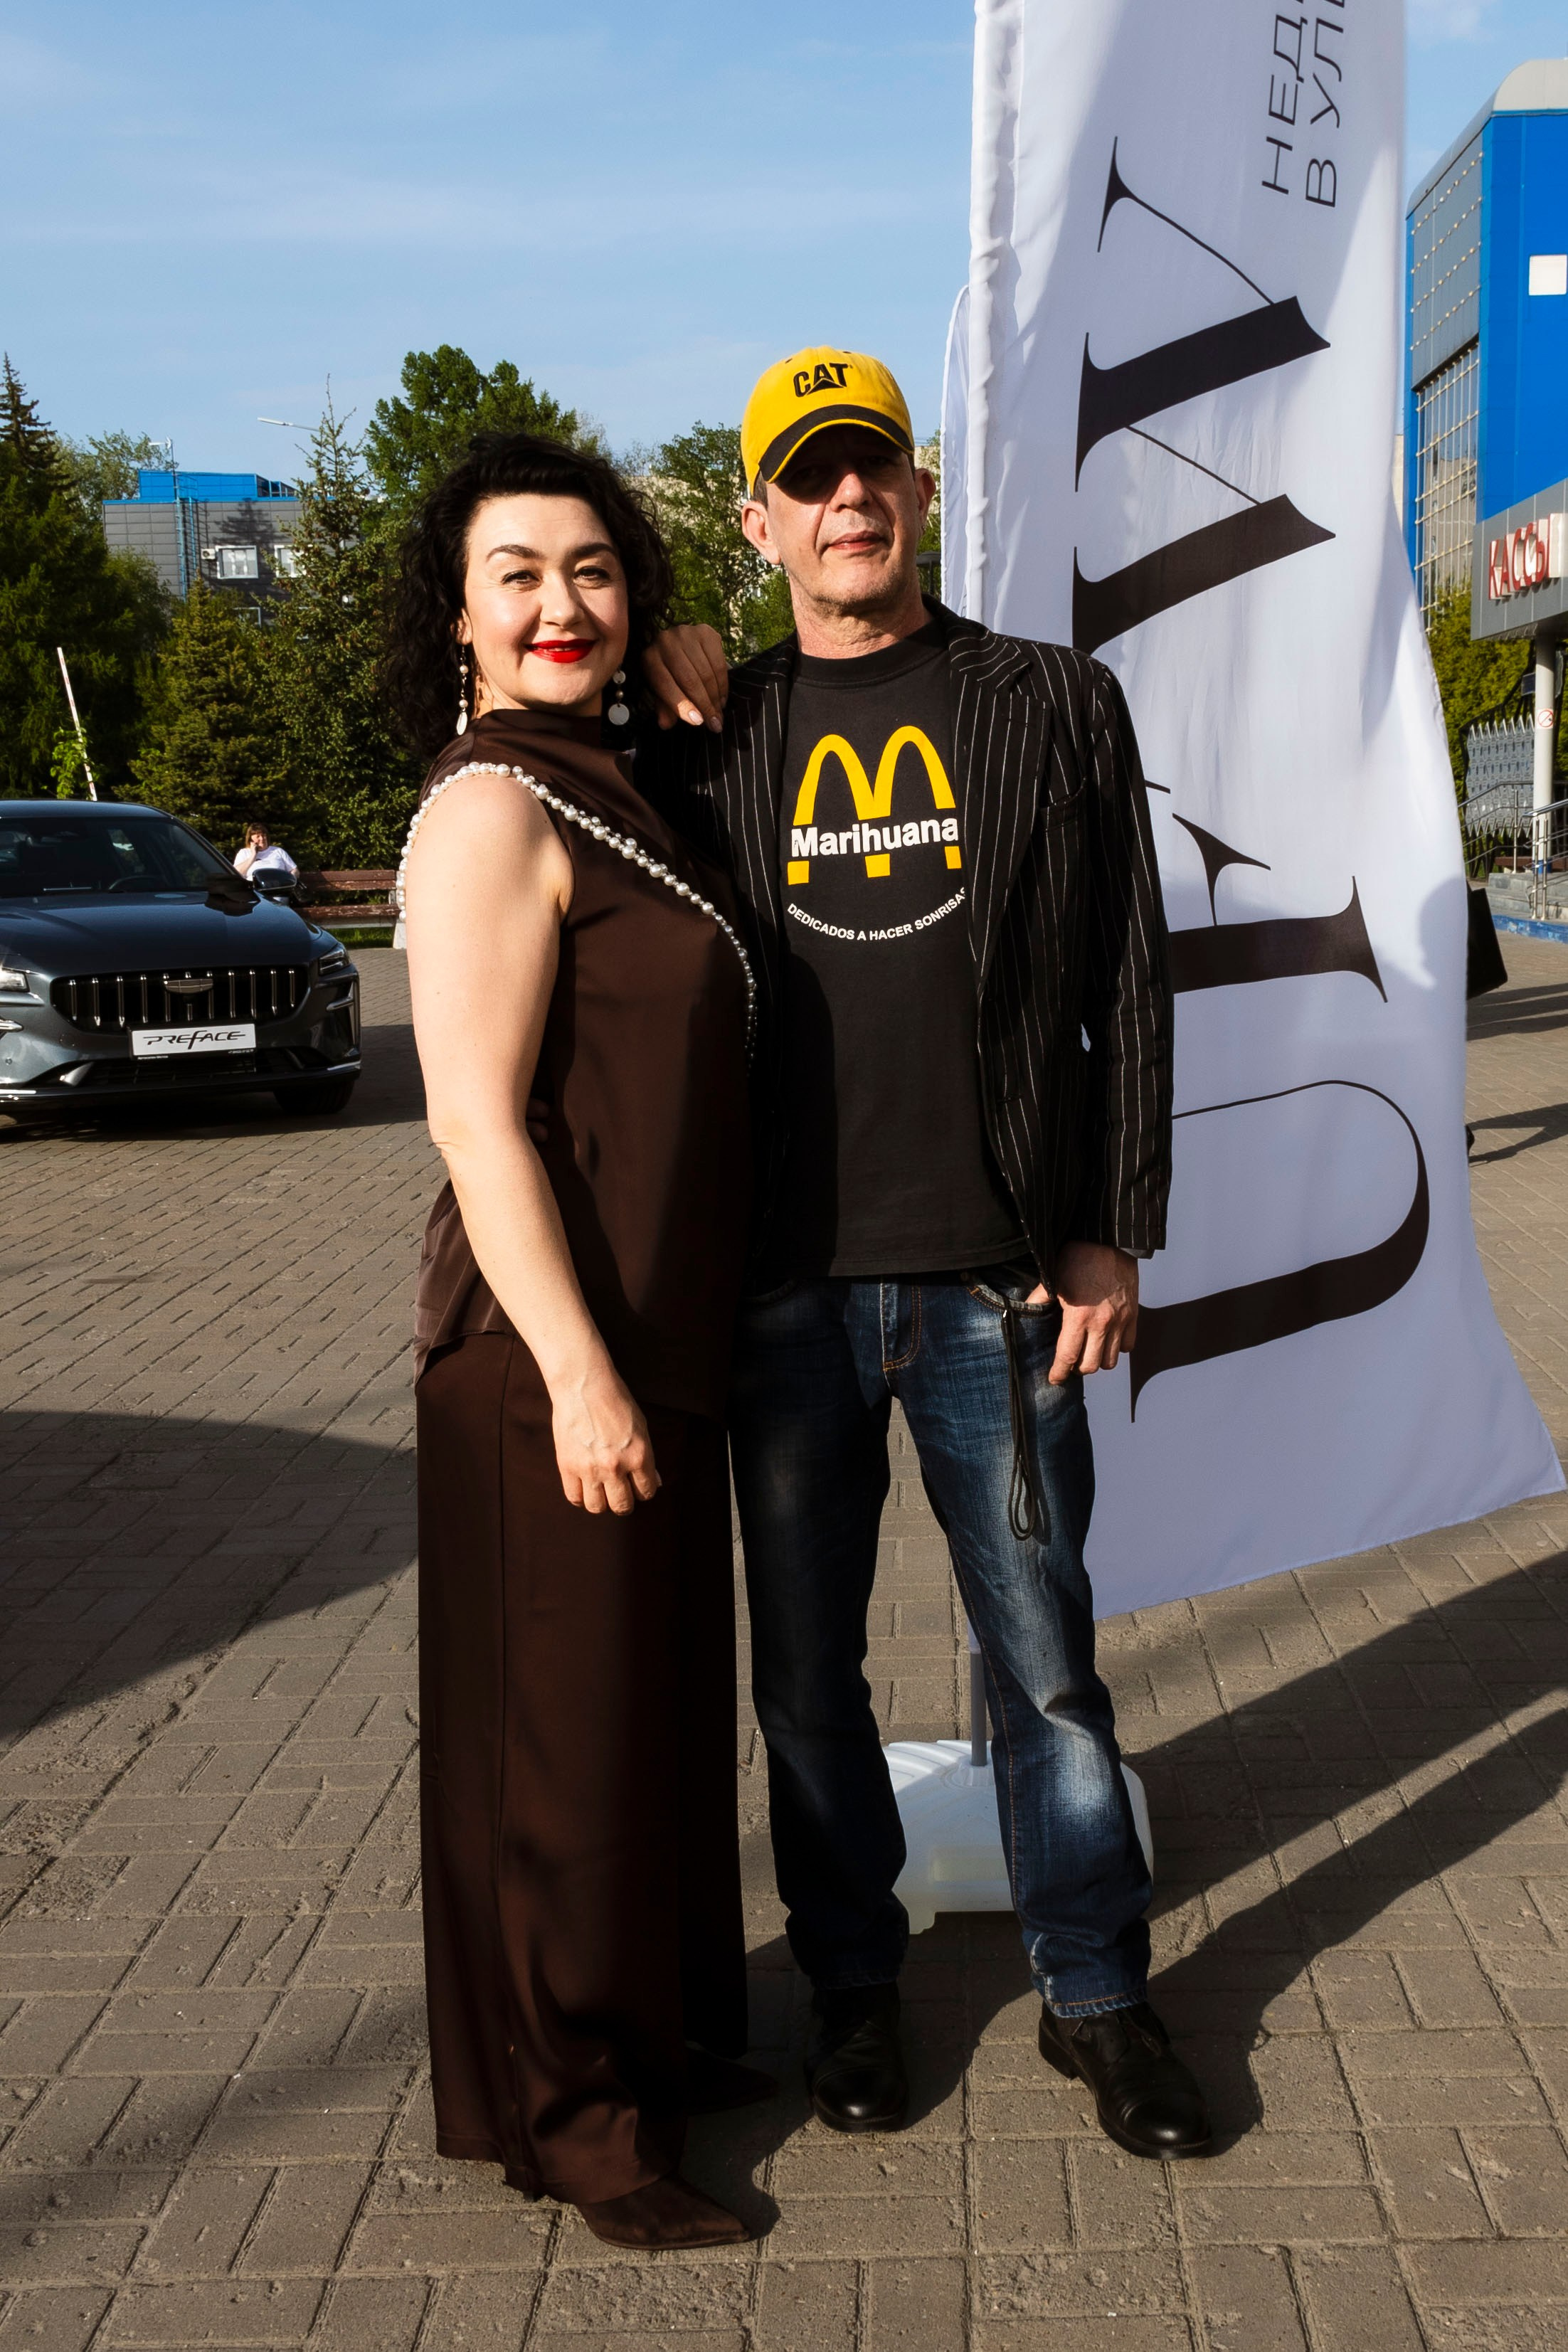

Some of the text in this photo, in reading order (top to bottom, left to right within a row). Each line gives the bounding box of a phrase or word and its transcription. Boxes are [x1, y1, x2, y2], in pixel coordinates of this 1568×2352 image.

[1261, 0, 1308, 195] НЕД
[1305, 0, 1345, 207] В УЛ
[793, 362, 849, 398] CAT
[1488, 513, 1561, 600] КАССЫ
[791, 818, 958, 857] Marihuana
[787, 903, 855, 941] DEDICADOS
[857, 931, 867, 941] A
[869, 923, 913, 941] HACER
[143, 1030, 246, 1049] PREFACE
